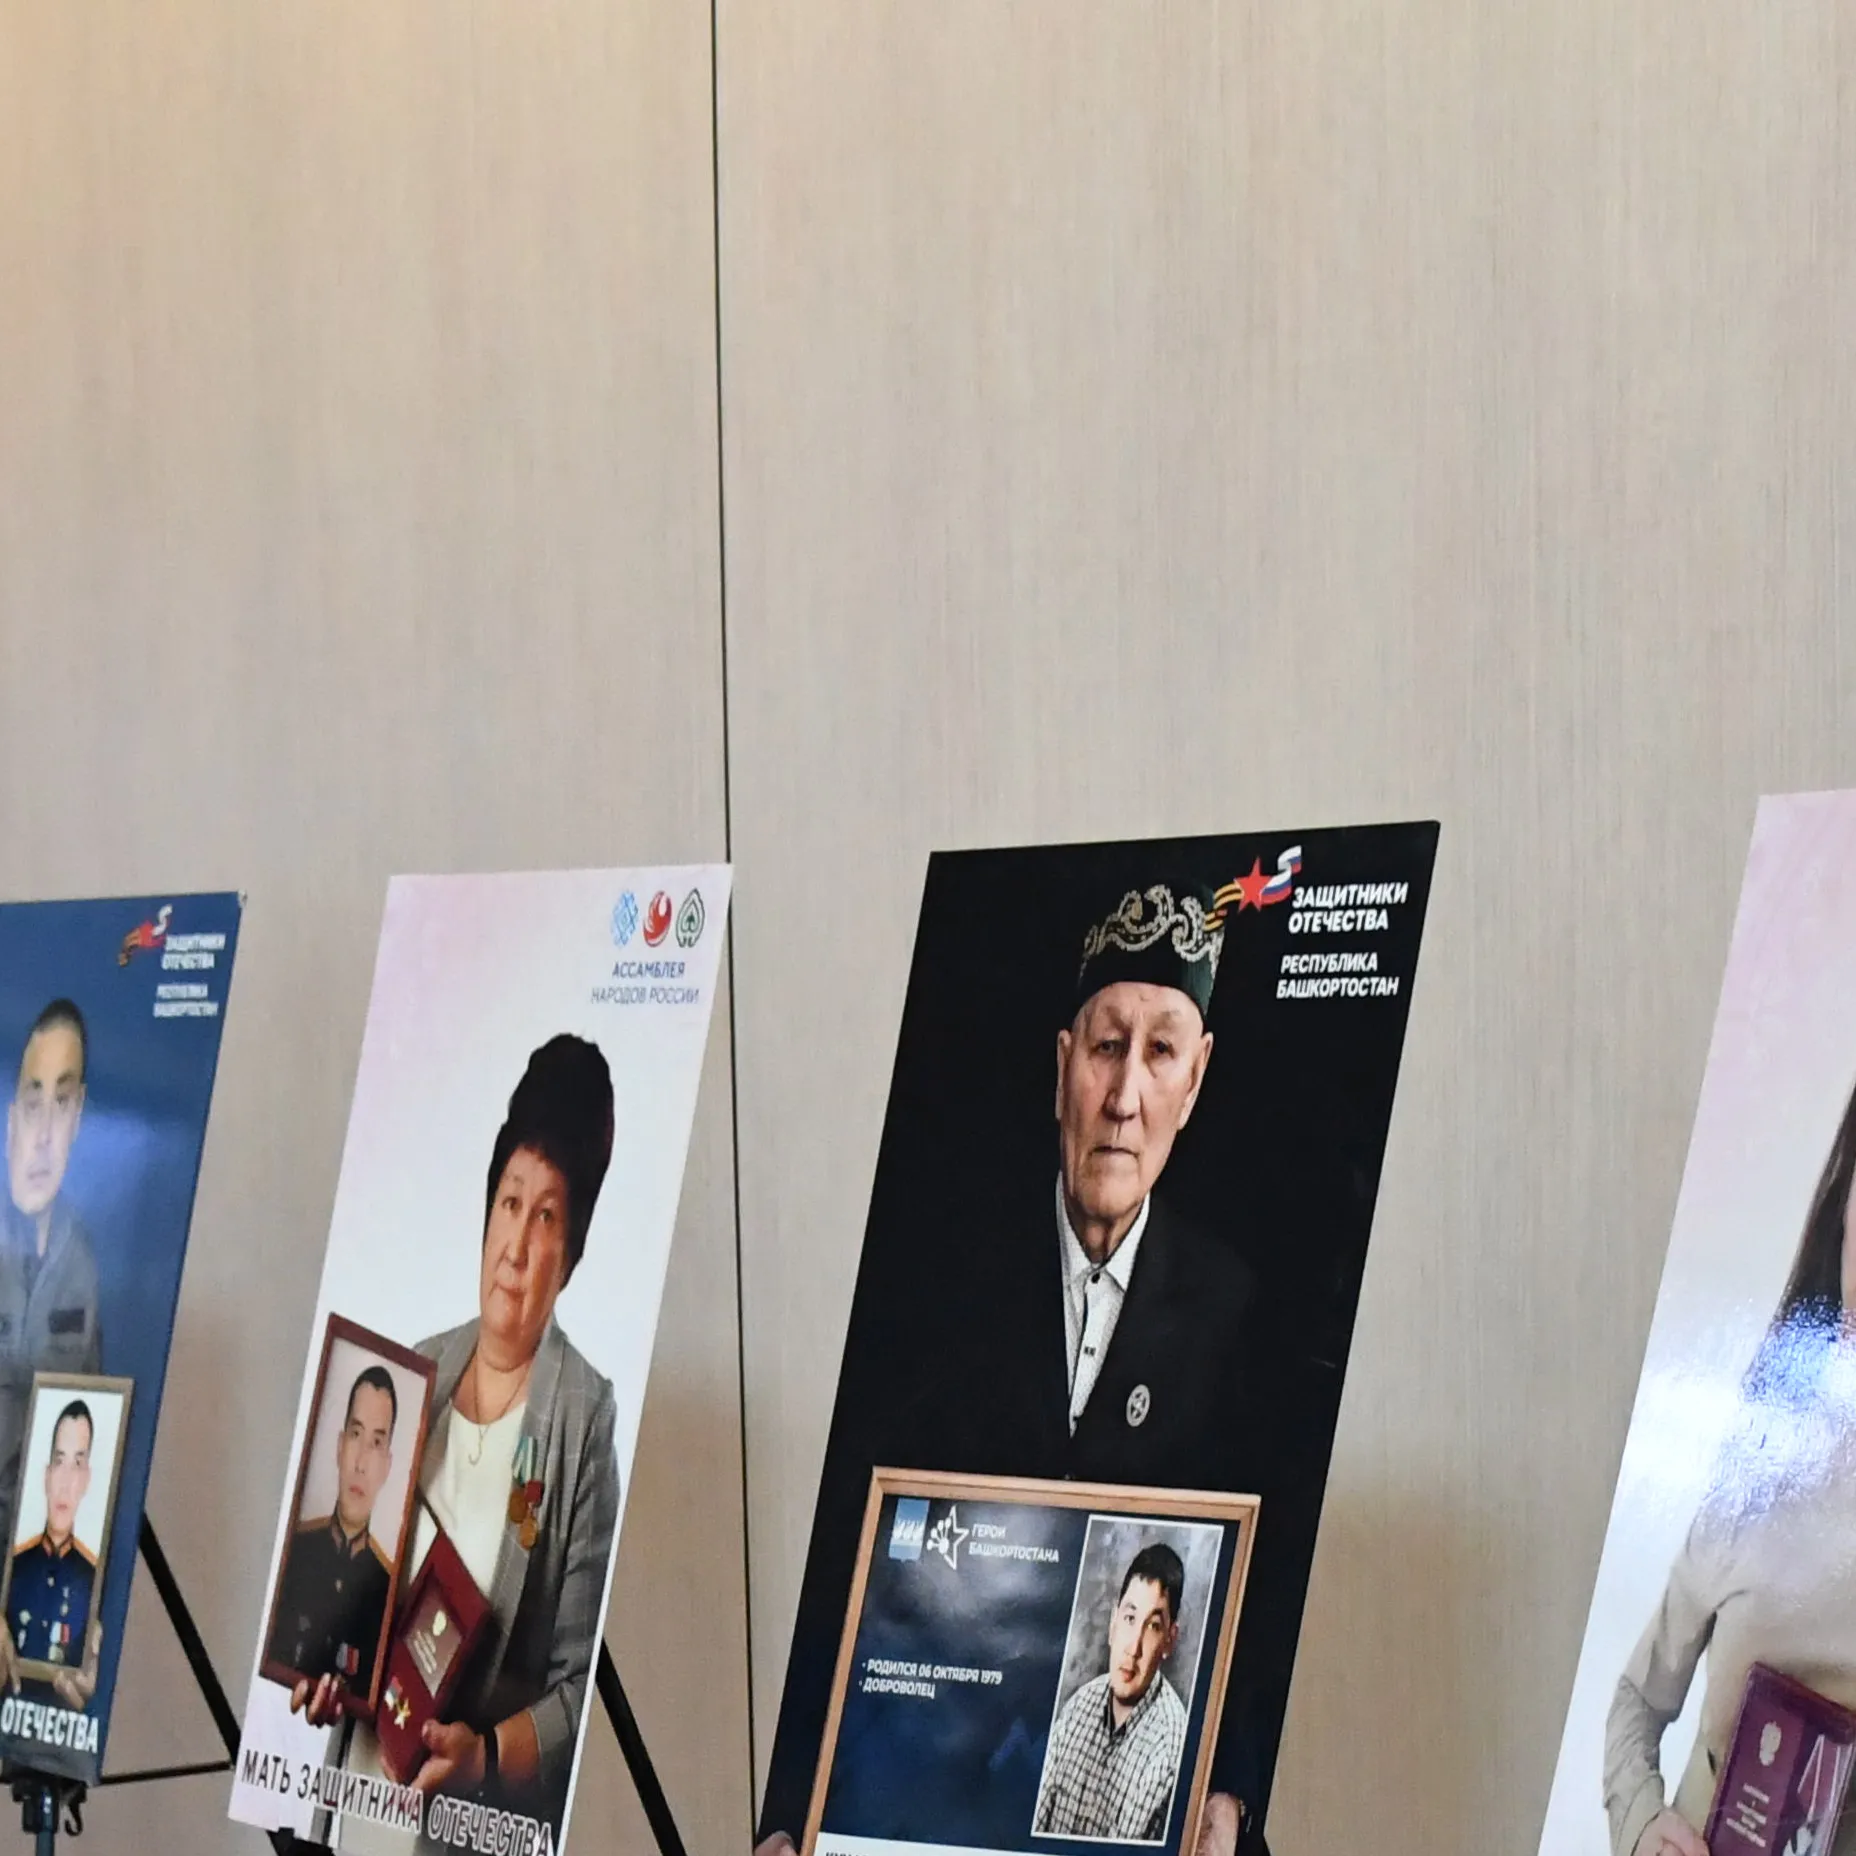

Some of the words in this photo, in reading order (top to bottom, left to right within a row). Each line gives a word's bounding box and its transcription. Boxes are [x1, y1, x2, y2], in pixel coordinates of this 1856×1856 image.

[1291, 882, 1409, 909] ЗАЩИТНИКИ
[1288, 908, 1389, 934] ОТЕЧЕСТВА
[612, 961, 685, 978] АССАМБЛЕЯ
[1280, 952, 1378, 974] РЕСПУБЛИКА
[591, 986, 647, 1004] НАРОДОВ
[649, 986, 700, 1004] РОССИИ
[1276, 976, 1400, 999] БАШКОРТОСТАН
[971, 1523, 1006, 1539] ГЕРОИ
[968, 1542, 1060, 1563] БАШКОРТОСТАНА
[867, 1659, 917, 1676] РОДИЛСЯ
[918, 1664, 931, 1678] 06
[933, 1666, 979, 1683] ОКТЯБРЯ
[980, 1670, 1003, 1685] 1979
[862, 1677, 936, 1699] ДОБРОВОЛЕЦ
[0, 1696, 99, 1754] ОТЕЧЕСТВА
[241, 1748, 291, 1795] МАТЬ
[296, 1762, 424, 1834] ЗАЩИТНИКА
